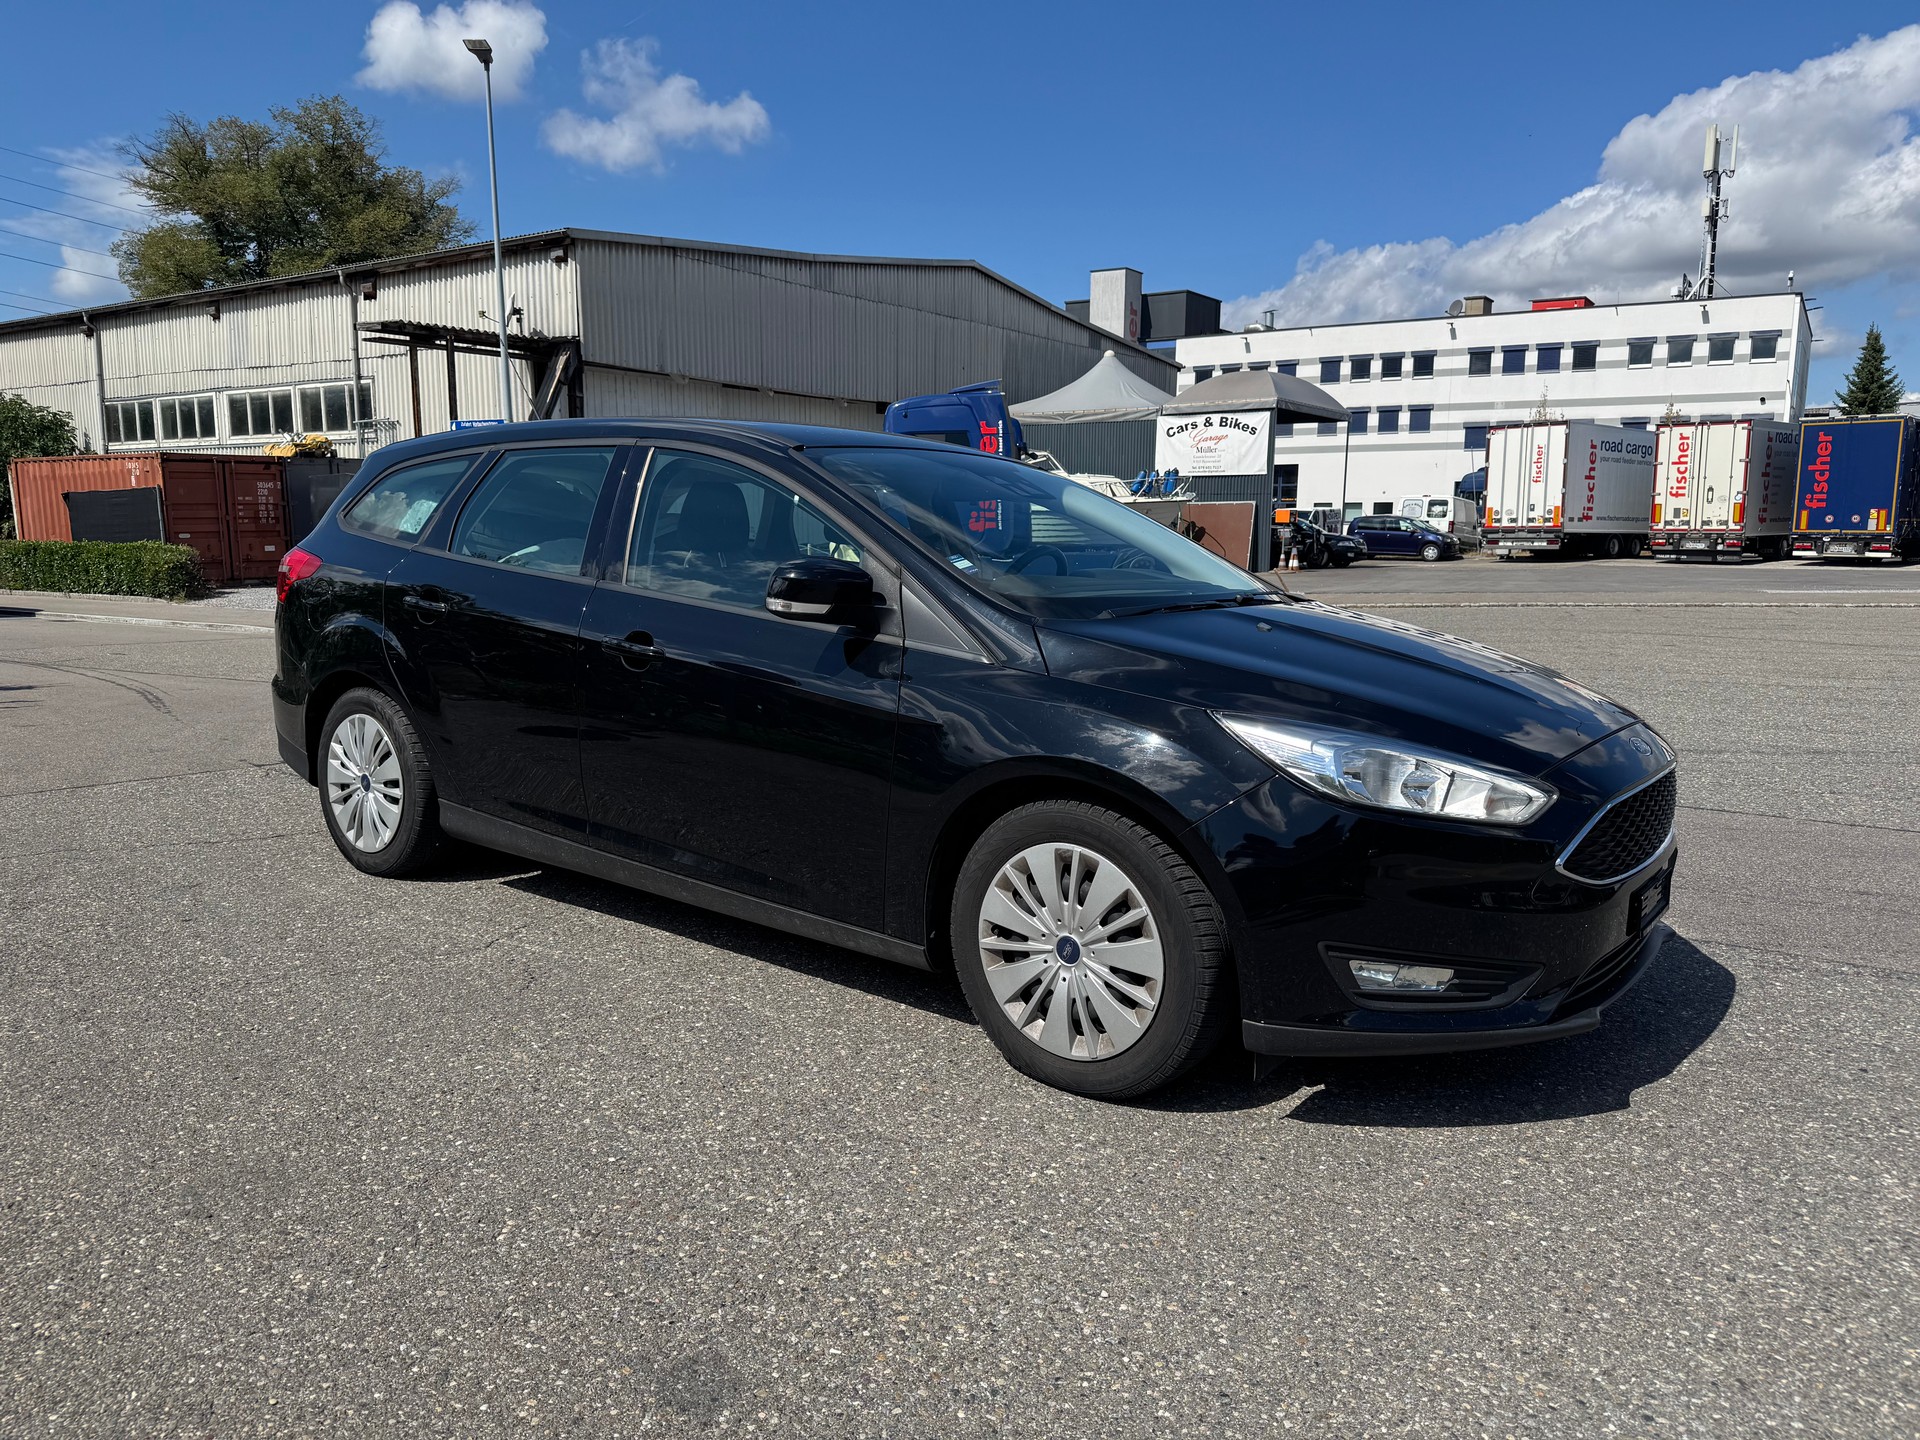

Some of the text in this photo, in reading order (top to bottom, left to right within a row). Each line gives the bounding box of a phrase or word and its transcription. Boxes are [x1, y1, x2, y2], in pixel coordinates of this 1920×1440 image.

[1166, 416, 1258, 438] Cars & Bikes
[1188, 428, 1229, 448] Garage
[1775, 429, 1793, 444] road
[1195, 446, 1218, 454] Müller
[1531, 444, 1545, 484] fischer
[1600, 438, 1653, 459] road cargo
[1581, 439, 1598, 522] fischer
[1669, 432, 1690, 499] fischer
[1757, 431, 1774, 524] fischer
[1804, 431, 1833, 509] fischer
